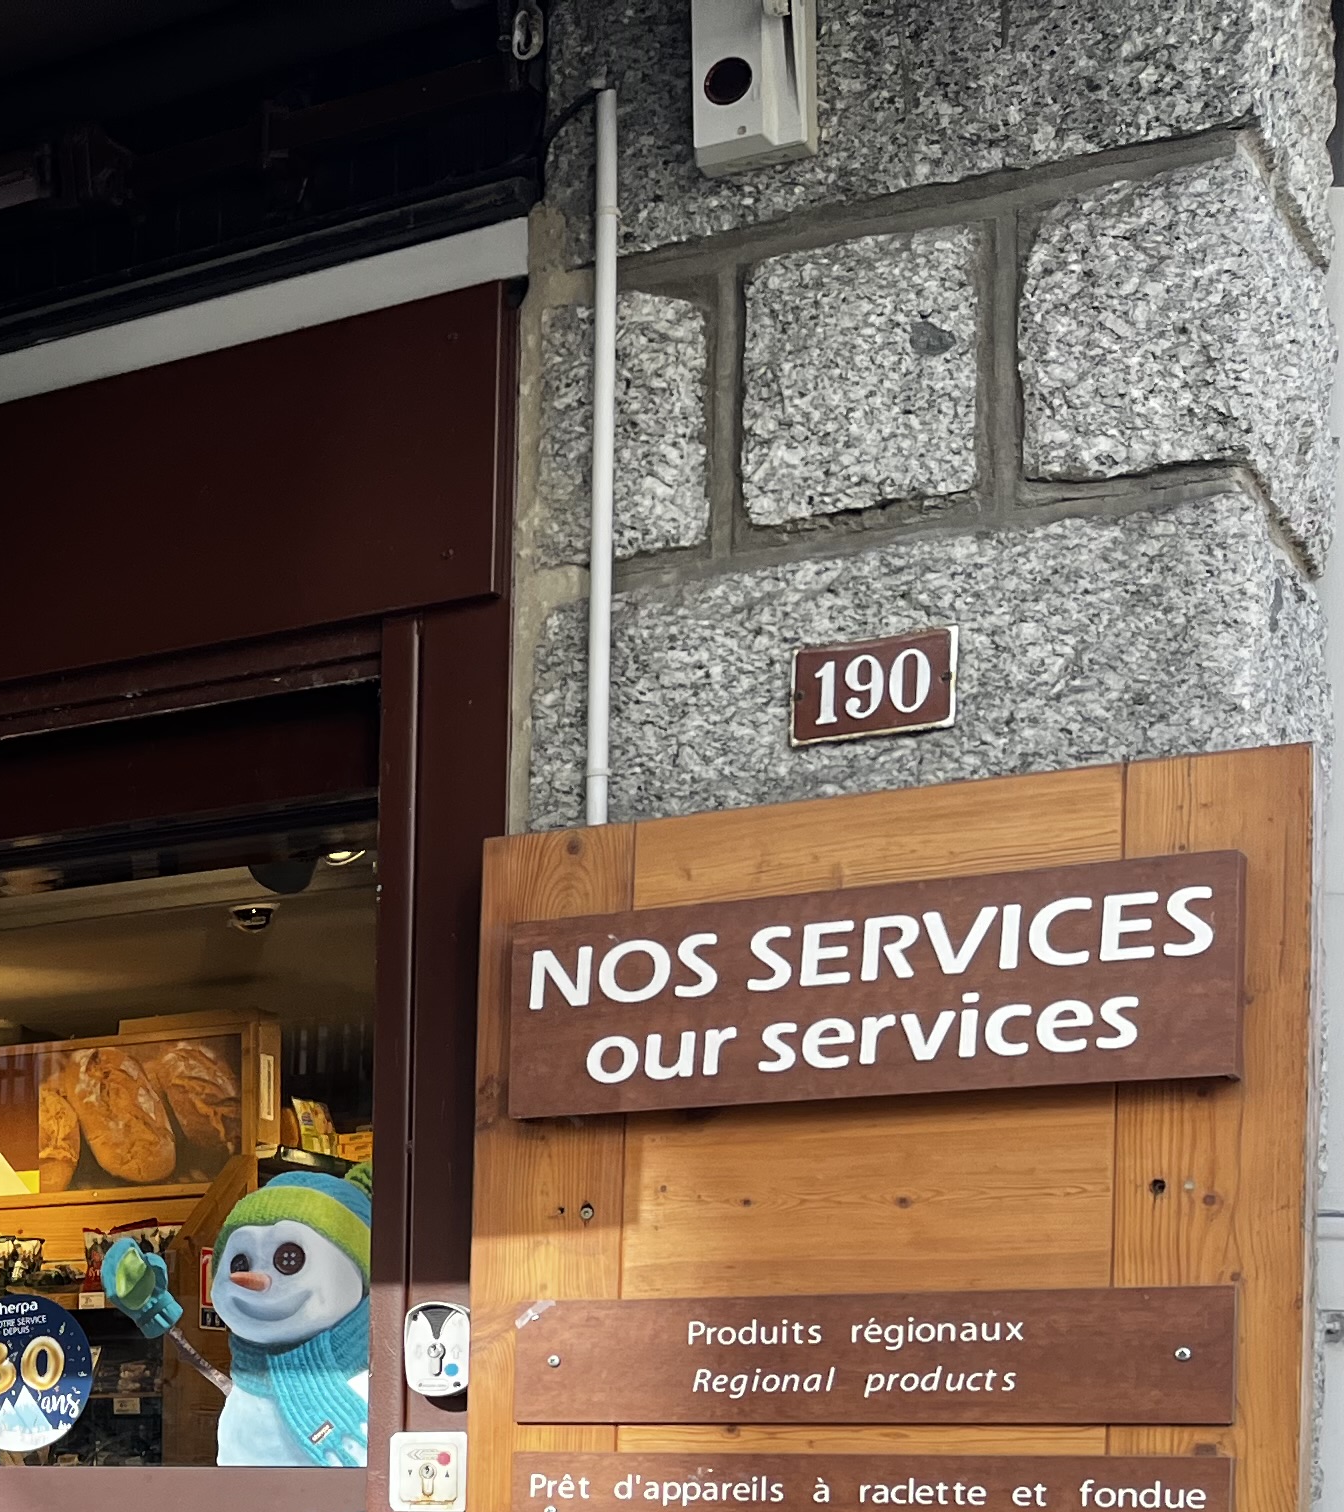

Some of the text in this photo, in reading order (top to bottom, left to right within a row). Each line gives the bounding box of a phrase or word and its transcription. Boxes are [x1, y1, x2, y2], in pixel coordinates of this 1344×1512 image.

[814, 646, 931, 725] 190
[529, 886, 1214, 1010] NOS SERVICES
[586, 992, 1139, 1084] our services
[3, 1326, 30, 1336] DEPUIS
[17, 1314, 46, 1326] SERVICE
[687, 1316, 1024, 1351] Produits régionaux
[692, 1365, 1017, 1399] Regional products
[40, 1393, 80, 1418] ans
[529, 1473, 1207, 1510] Prêt d'appareils à raclette et fondue
